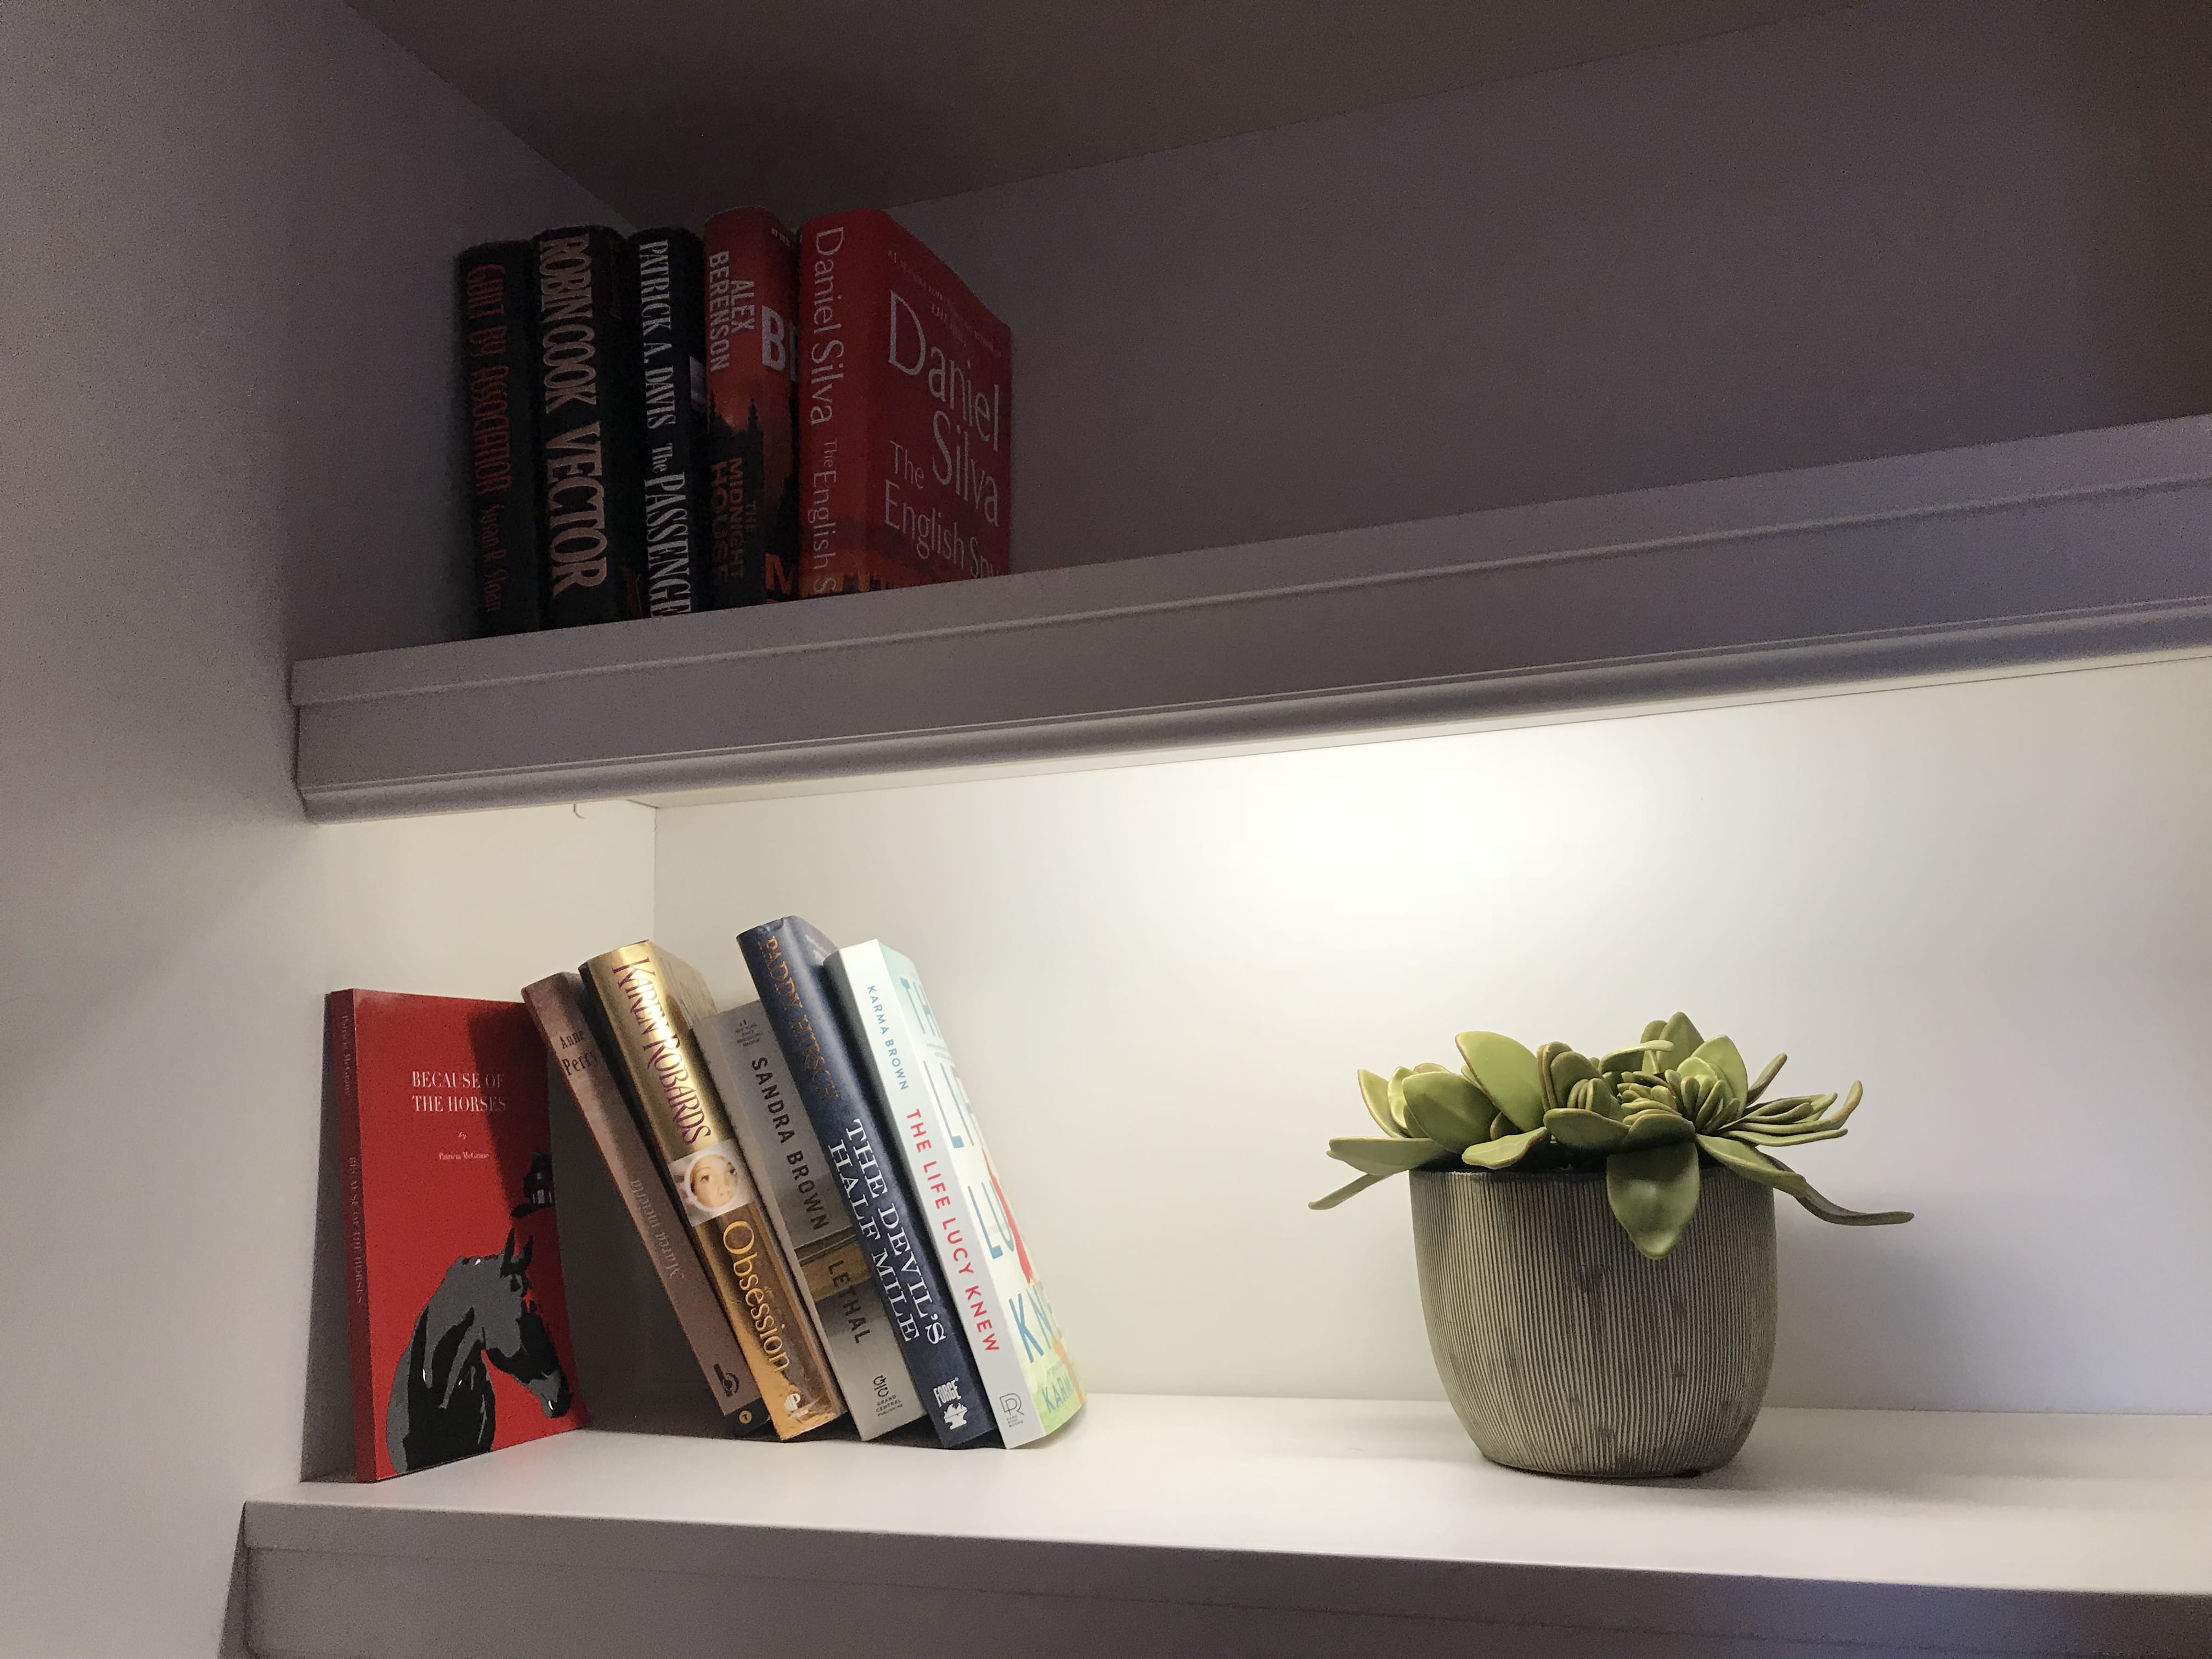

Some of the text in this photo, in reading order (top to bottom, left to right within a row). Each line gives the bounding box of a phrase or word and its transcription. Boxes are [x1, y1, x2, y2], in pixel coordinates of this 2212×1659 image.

[465, 263, 506, 320] GUILT
[639, 239, 672, 336] PATRICK
[709, 251, 730, 373] BERENSON
[731, 280, 755, 334] ALEX
[814, 227, 844, 334] Daniel
[643, 341, 673, 364] A.
[645, 364, 676, 430] DAVIS
[810, 339, 844, 426] Silva
[888, 290, 1000, 452] Daniel
[539, 233, 608, 597] ROBIN COOK VECTOR
[651, 443, 674, 474] The
[823, 439, 838, 467] The
[889, 439, 924, 489] The
[932, 410, 1000, 528] Silva
[729, 456, 746, 578] MIDNIGHT
[808, 470, 837, 569] English
[884, 479, 966, 569] English
[758, 935, 803, 1011] PADDY
[411, 1070, 505, 1088] BECAUSE OF
[560, 1031, 586, 1049] Anne
[561, 1050, 598, 1076] Perry
[612, 957, 712, 1145] KAREN ROBARDS
[867, 985, 909, 1091] KARMA BROWN
[411, 1094, 506, 1113] THE HORSES
[752, 1057, 795, 1143] SANDRA
[787, 1150, 830, 1230] BROWN
[828, 1139, 920, 1343] HALF MILE
[845, 1118, 946, 1345] THE DEVIL'S
[906, 1108, 1000, 1351] THE LIFE LUCY KNEW
[723, 1220, 791, 1372] Obsession
[828, 1260, 871, 1344] LETHAL
[933, 1379, 962, 1408] FORGE
